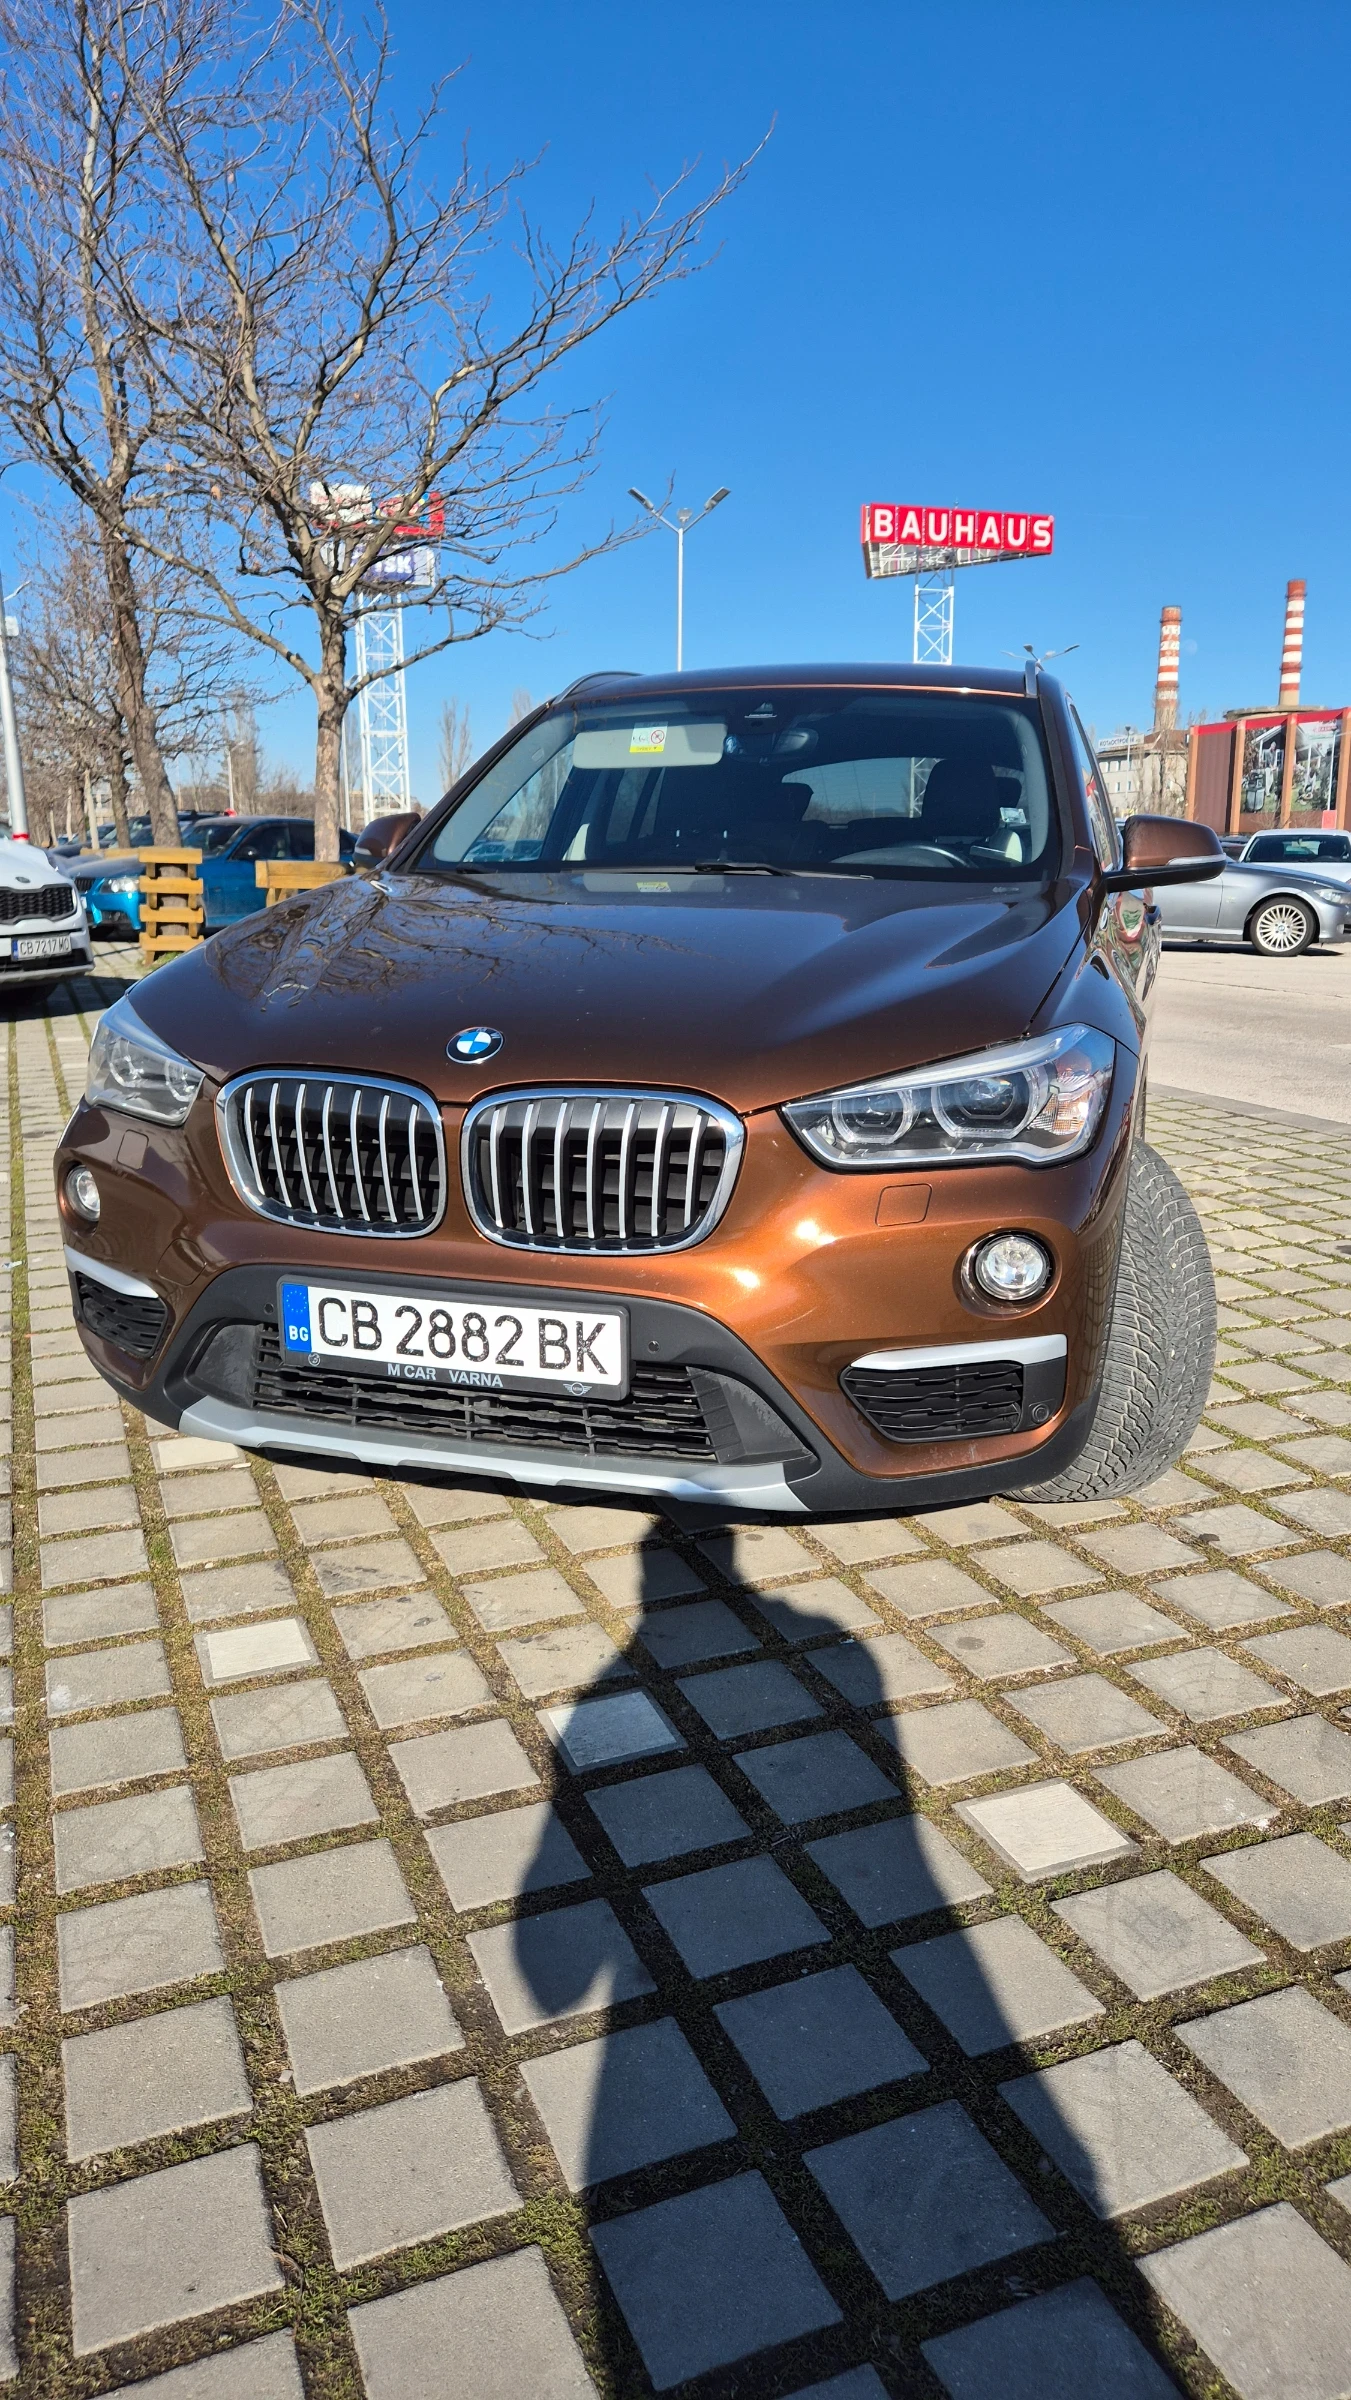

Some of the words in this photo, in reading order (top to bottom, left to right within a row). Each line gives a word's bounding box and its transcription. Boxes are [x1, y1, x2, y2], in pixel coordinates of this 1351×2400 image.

[874, 509, 1052, 547] BAUHAUS
[20, 941, 33, 955] CB
[35, 939, 57, 953] 7217
[288, 1325, 309, 1342] BG
[318, 1297, 383, 1351] CB
[395, 1304, 525, 1366] 2882
[537, 1317, 609, 1376] BK
[387, 1363, 401, 1377] M
[403, 1365, 437, 1381] CAR
[448, 1370, 504, 1388] VARNA
